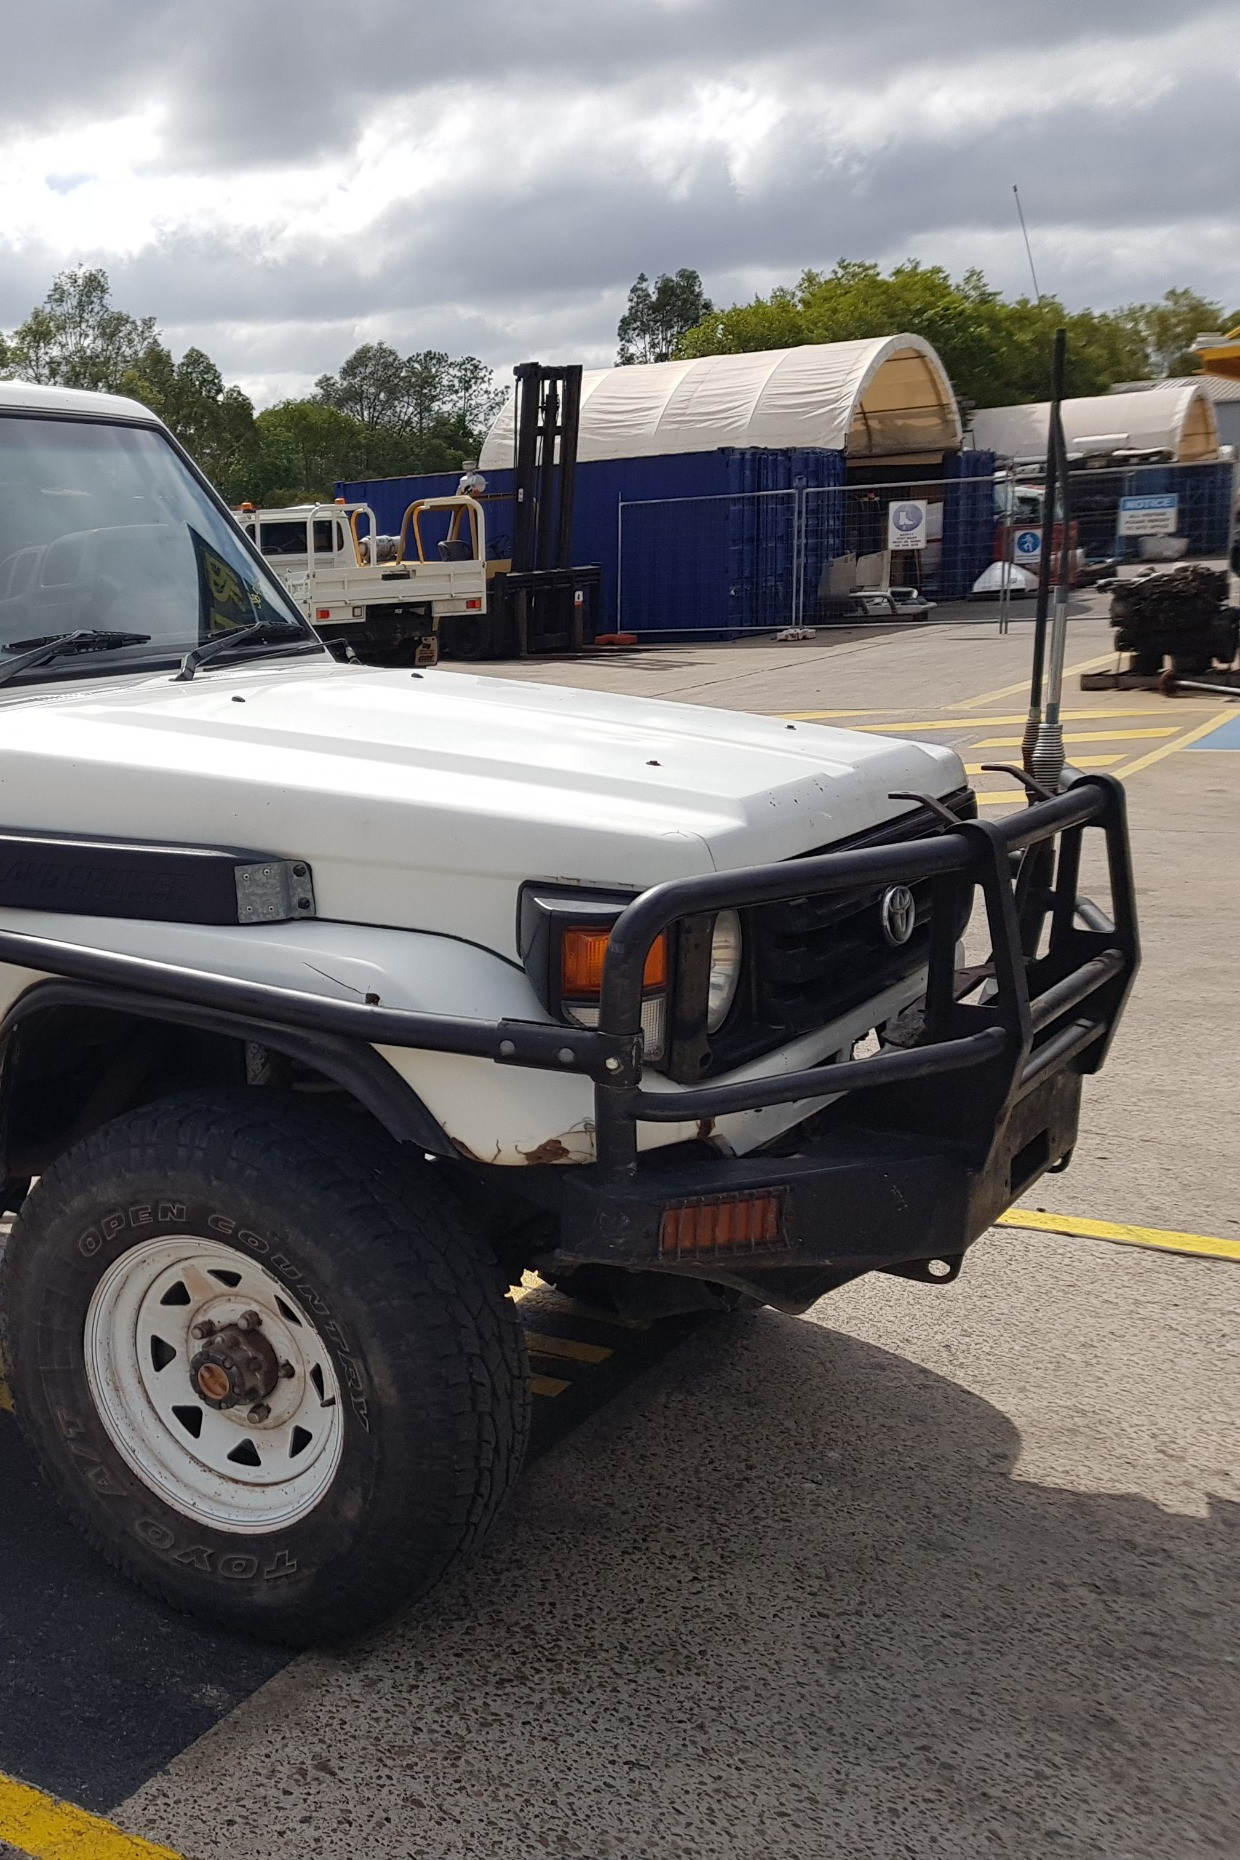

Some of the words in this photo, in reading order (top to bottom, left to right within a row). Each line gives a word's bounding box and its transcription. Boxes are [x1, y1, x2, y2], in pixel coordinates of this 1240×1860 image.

[78, 1203, 187, 1258] OPEN
[207, 1213, 371, 1435] COUNTRY
[134, 1517, 298, 1580] TOYO
